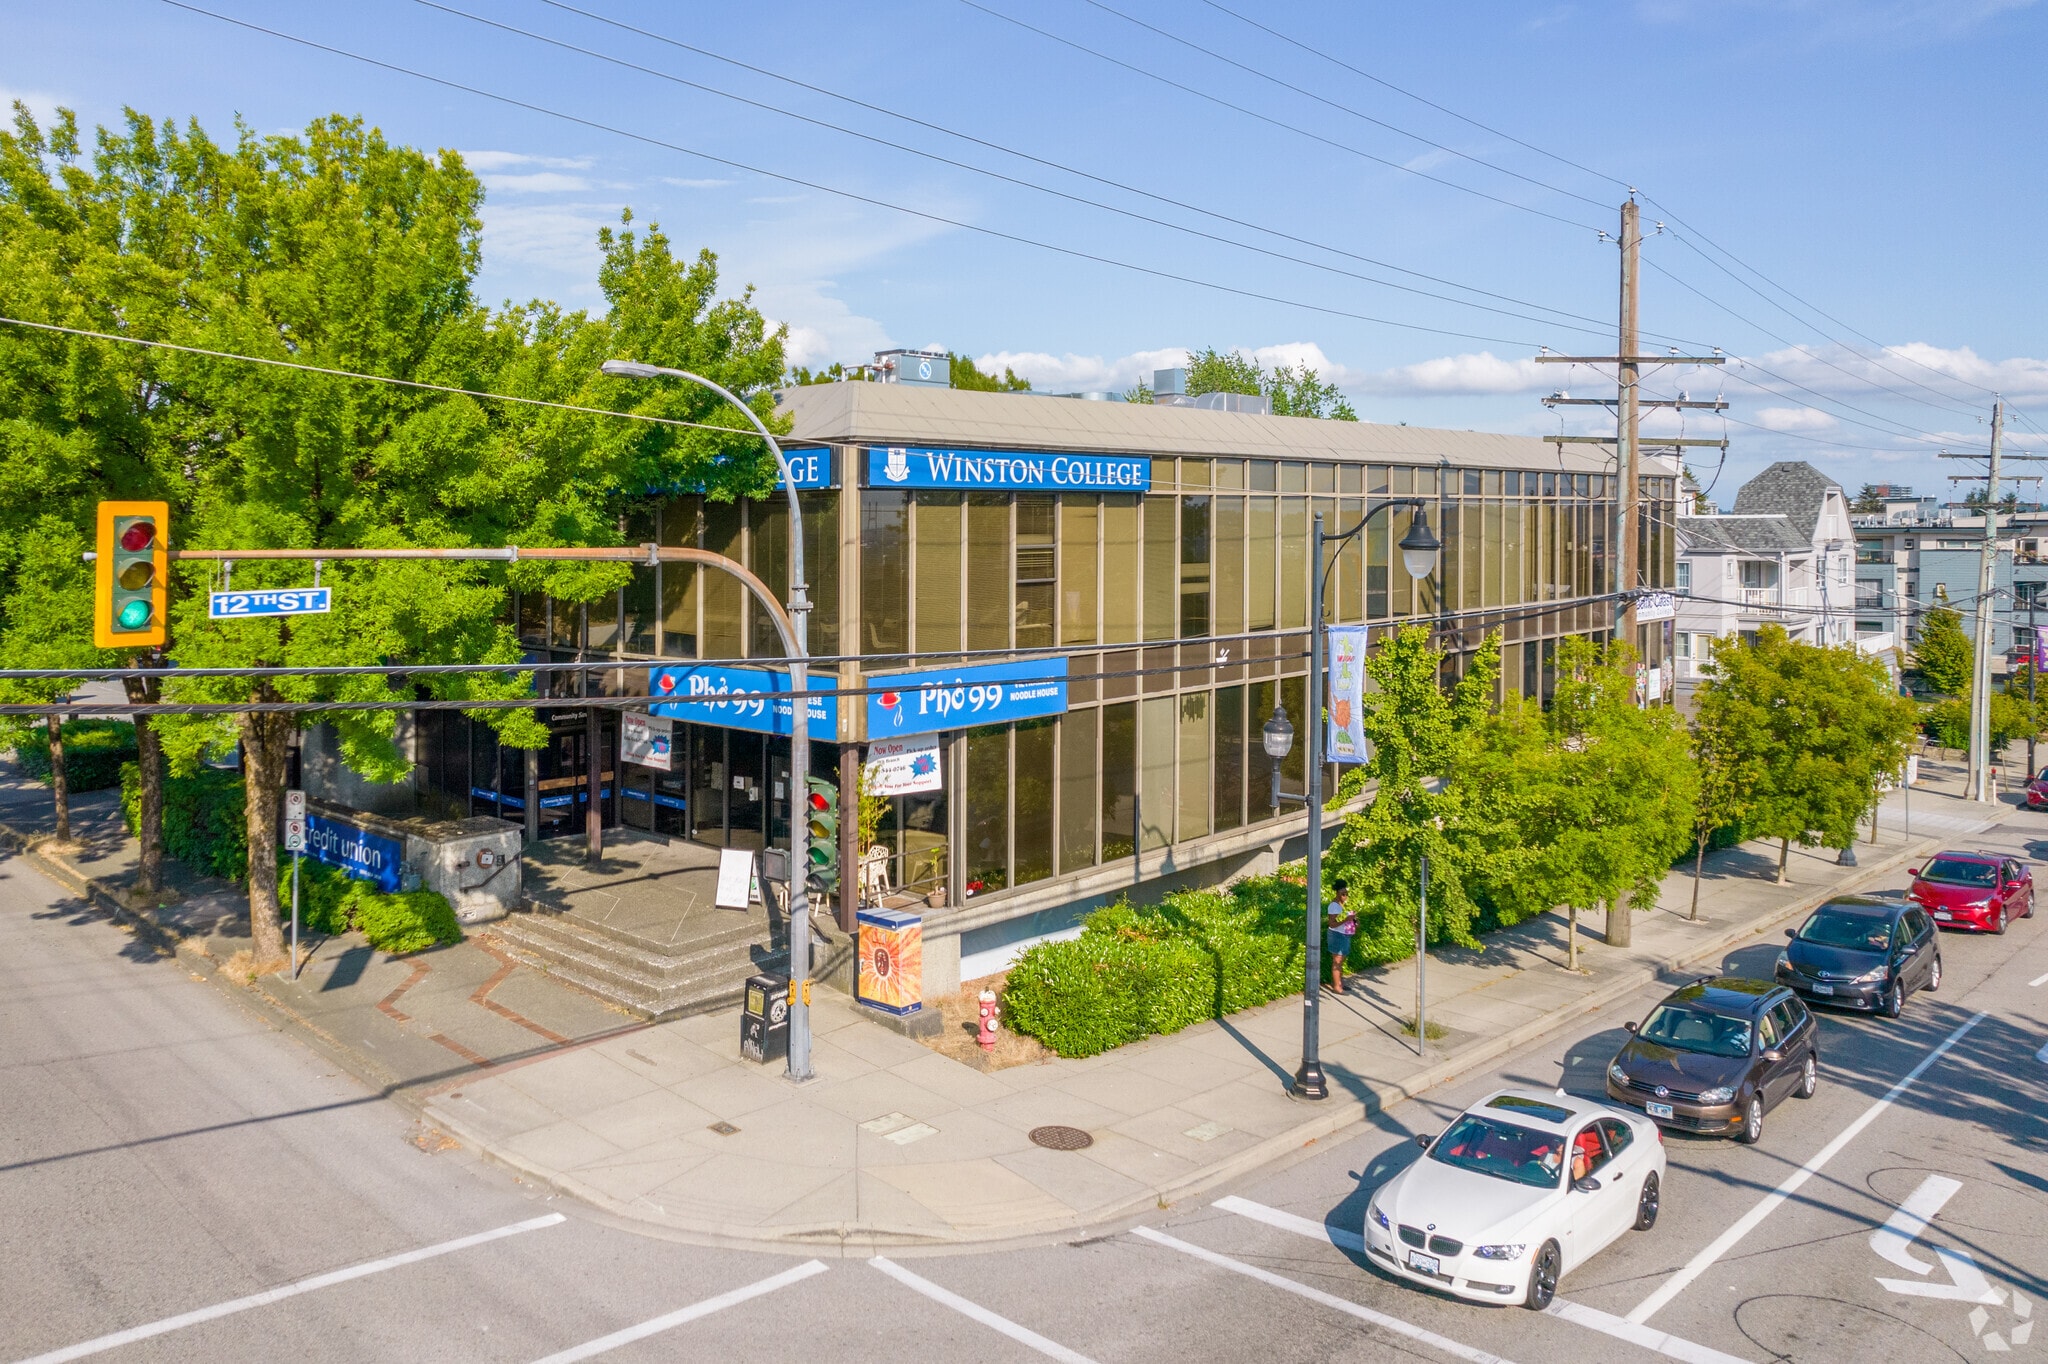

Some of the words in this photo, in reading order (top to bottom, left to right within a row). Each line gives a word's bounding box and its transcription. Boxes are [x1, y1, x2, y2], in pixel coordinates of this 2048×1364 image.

[732, 688, 765, 717] 99
[968, 684, 1003, 713] 99
[1010, 690, 1036, 701] NOODLE
[1036, 687, 1059, 698] HOUSE
[772, 705, 793, 716] NOOD
[807, 708, 827, 720] OUSE
[887, 744, 903, 755] Open
[305, 826, 339, 854] redit
[340, 838, 381, 869] union
